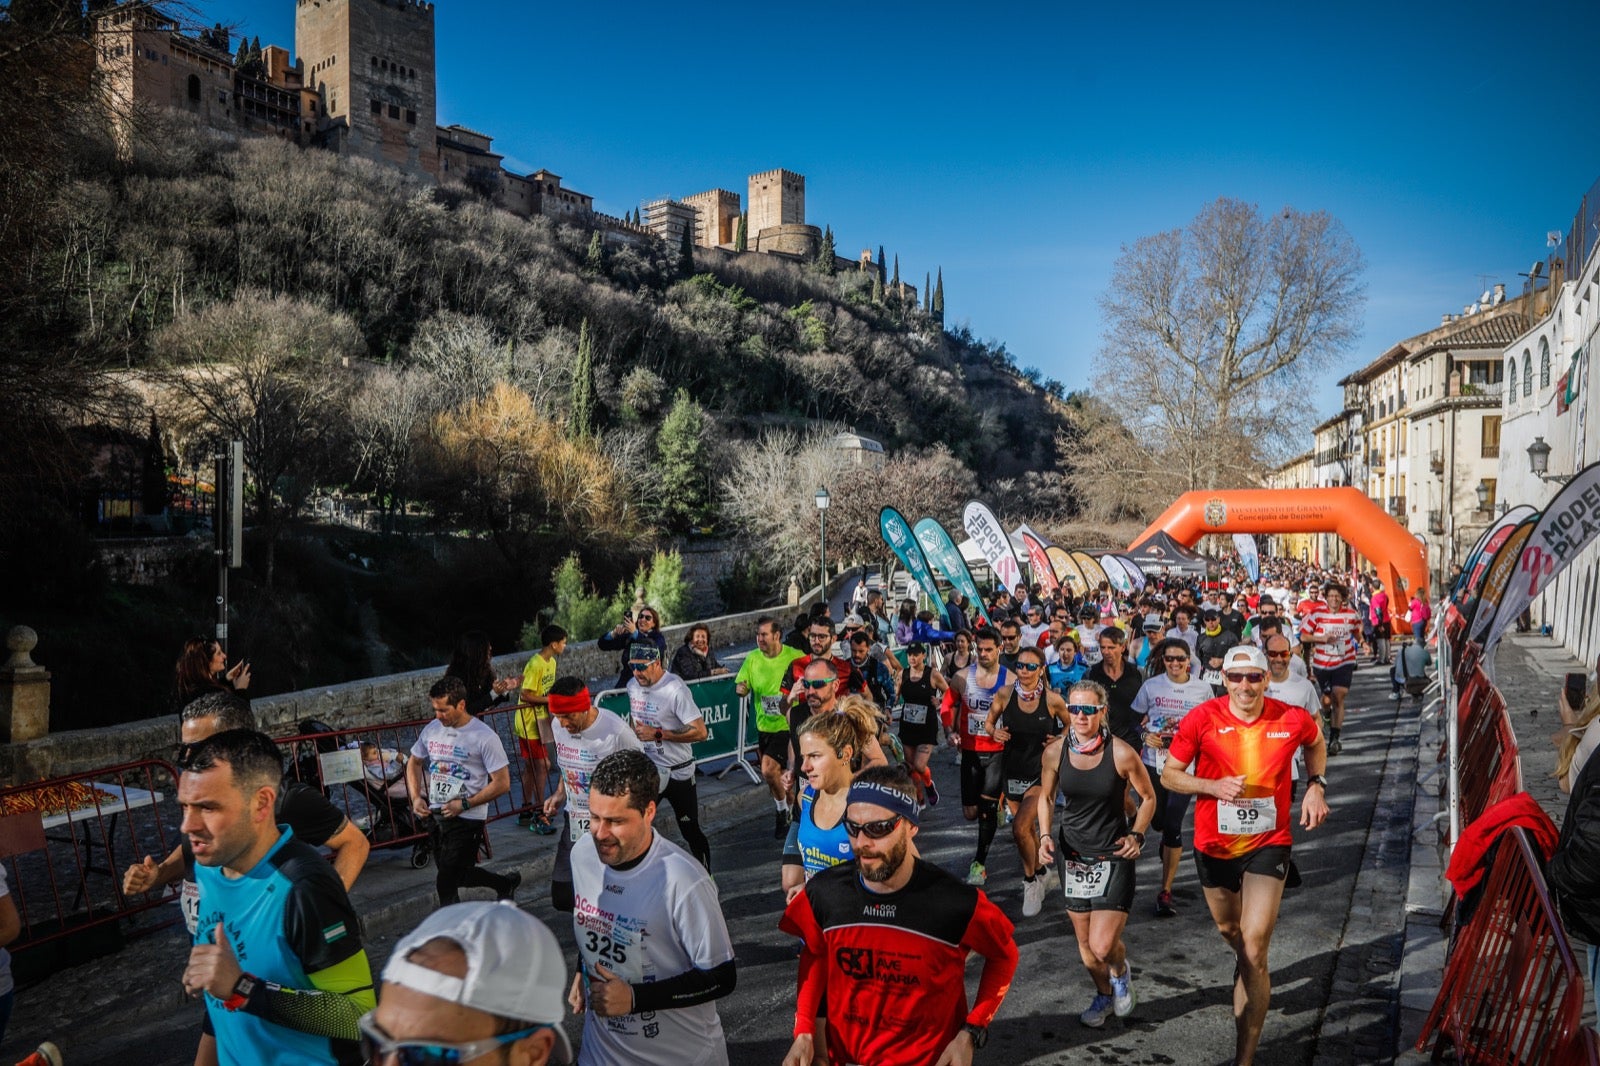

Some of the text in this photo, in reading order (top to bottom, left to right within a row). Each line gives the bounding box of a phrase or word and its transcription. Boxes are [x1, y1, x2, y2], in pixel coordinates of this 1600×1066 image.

[1290, 512, 1324, 520] Deportes
[968, 698, 992, 712] US
[436, 782, 452, 794] 127
[1236, 808, 1258, 820] 99
[578, 819, 590, 830] 12
[1075, 870, 1102, 884] 562
[581, 898, 615, 922] Carrera
[863, 904, 896, 918] Altium
[577, 912, 585, 926] 9
[586, 930, 627, 964] 325
[876, 958, 902, 971] AVE
